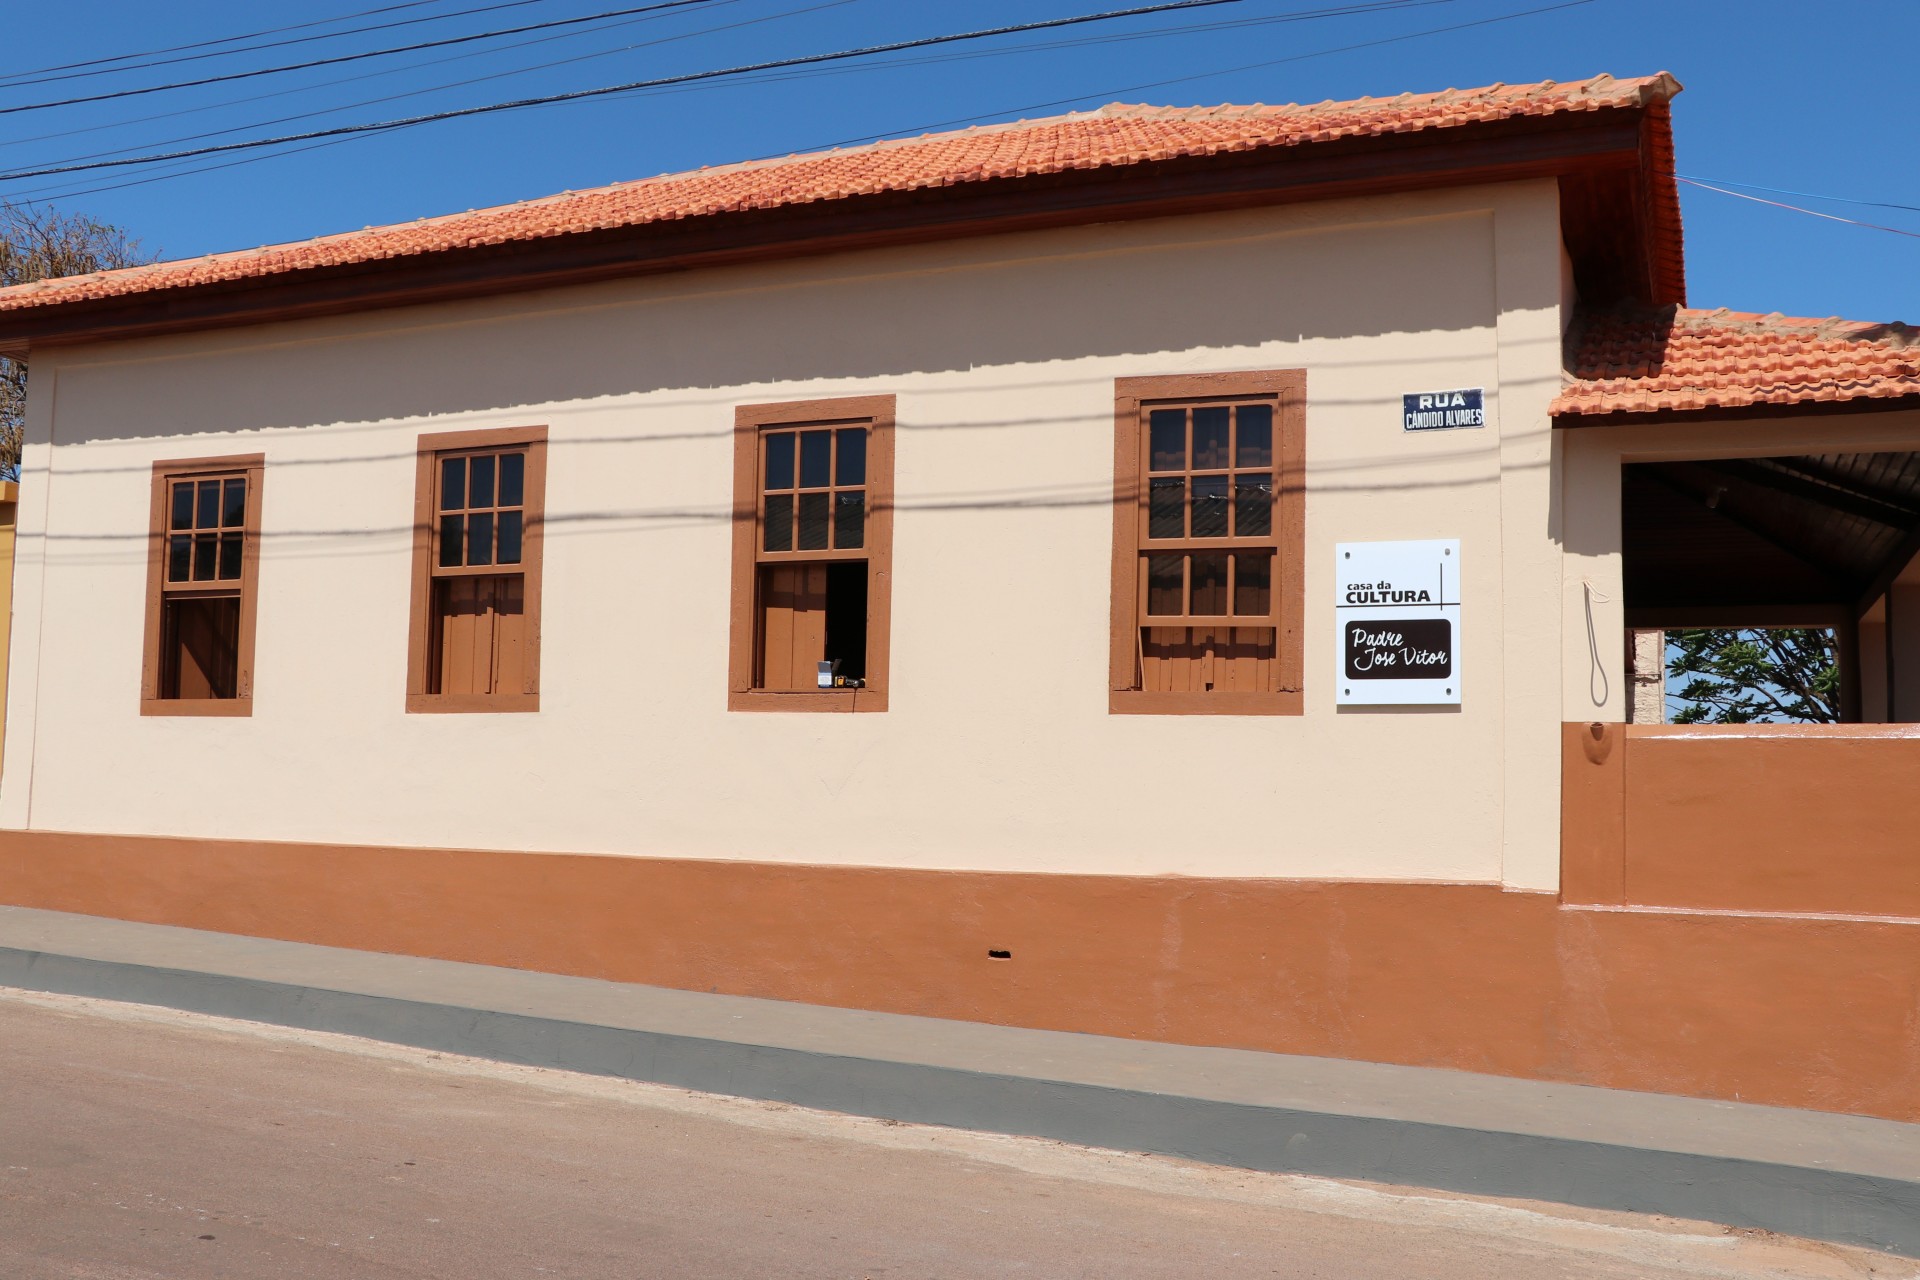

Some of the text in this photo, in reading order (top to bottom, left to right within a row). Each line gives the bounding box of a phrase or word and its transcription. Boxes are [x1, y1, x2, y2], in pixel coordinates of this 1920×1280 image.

[1420, 393, 1466, 409] RUA
[1446, 409, 1482, 426] ALVARES
[1377, 581, 1391, 590] da
[1345, 590, 1431, 604] CULTURA
[1352, 628, 1403, 647] Padre
[1398, 646, 1448, 666] Vitor
